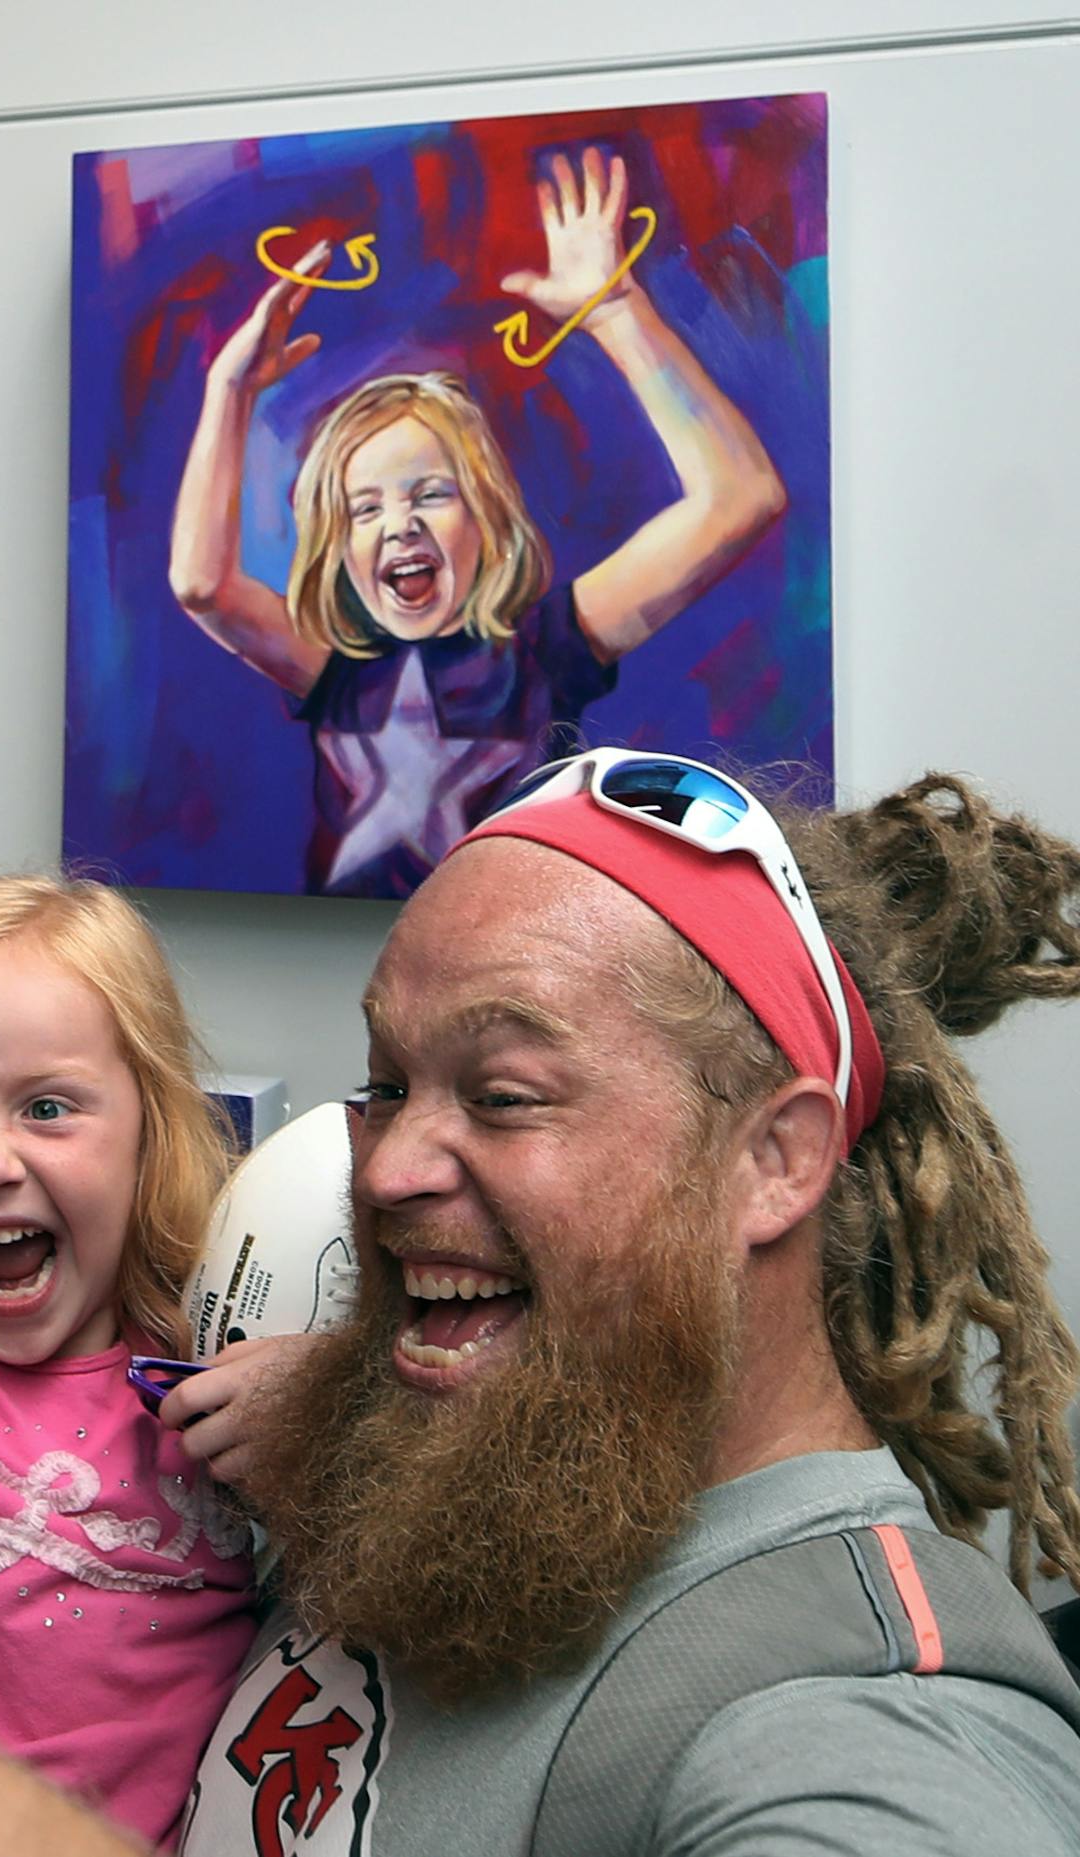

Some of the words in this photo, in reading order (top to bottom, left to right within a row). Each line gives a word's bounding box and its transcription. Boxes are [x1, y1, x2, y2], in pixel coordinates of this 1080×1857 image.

[225, 1233, 255, 1301] NATIONAL
[237, 1260, 259, 1320] CONFERENCE
[247, 1270, 265, 1316] FOOTBALL
[255, 1272, 273, 1320] AMERICAN
[197, 1290, 219, 1357] Wilson
